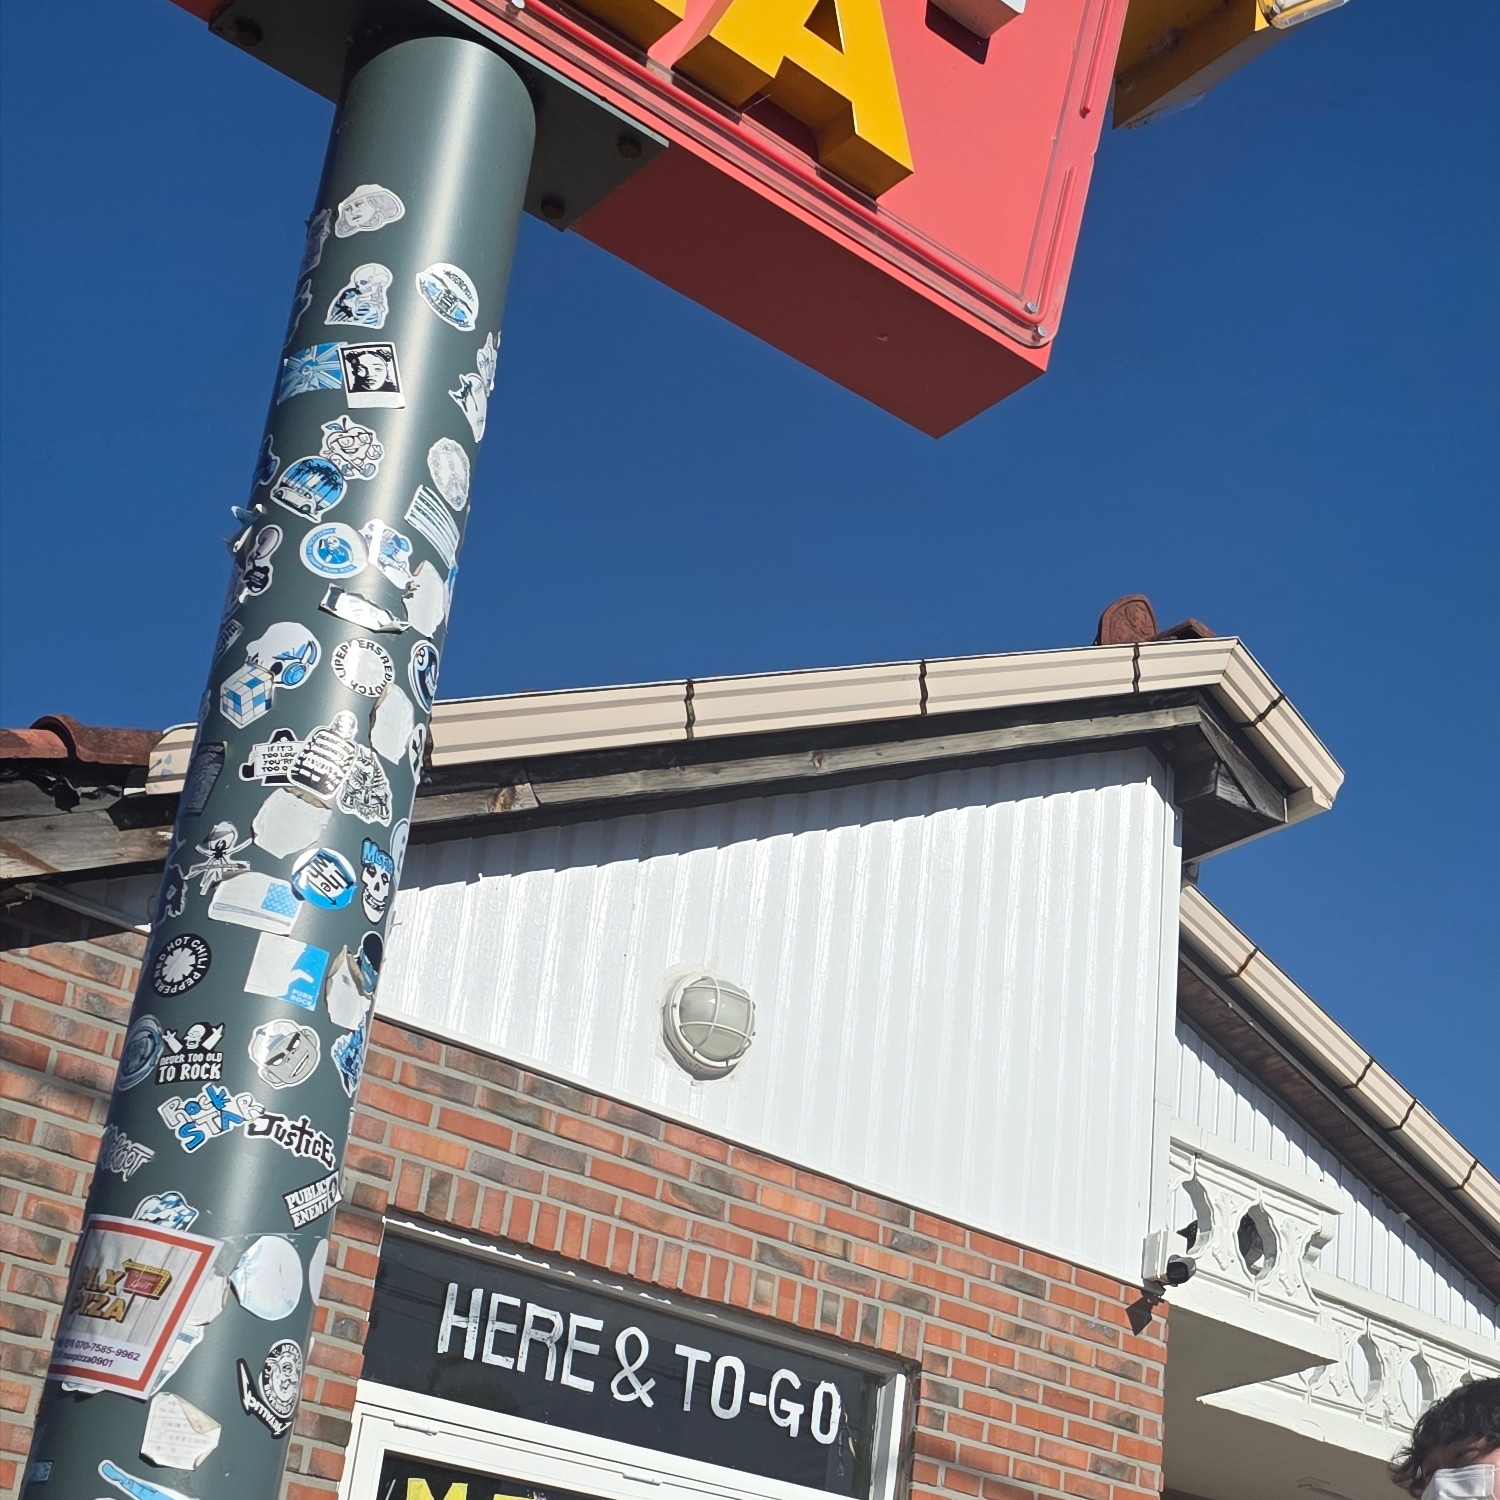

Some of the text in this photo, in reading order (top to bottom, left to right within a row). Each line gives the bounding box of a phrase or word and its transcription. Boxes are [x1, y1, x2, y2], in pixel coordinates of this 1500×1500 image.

[166, 936, 191, 952] HOT
[191, 939, 208, 969] CHILI
[154, 971, 202, 994] PEPPERS
[187, 1053, 204, 1063] TOO
[206, 1052, 223, 1062] OLD
[159, 1063, 222, 1083] TO ROCK
[284, 1179, 327, 1209] PUBLIC
[291, 1197, 328, 1227] ENEMY
[437, 1282, 842, 1445] HERE & TO-GO
